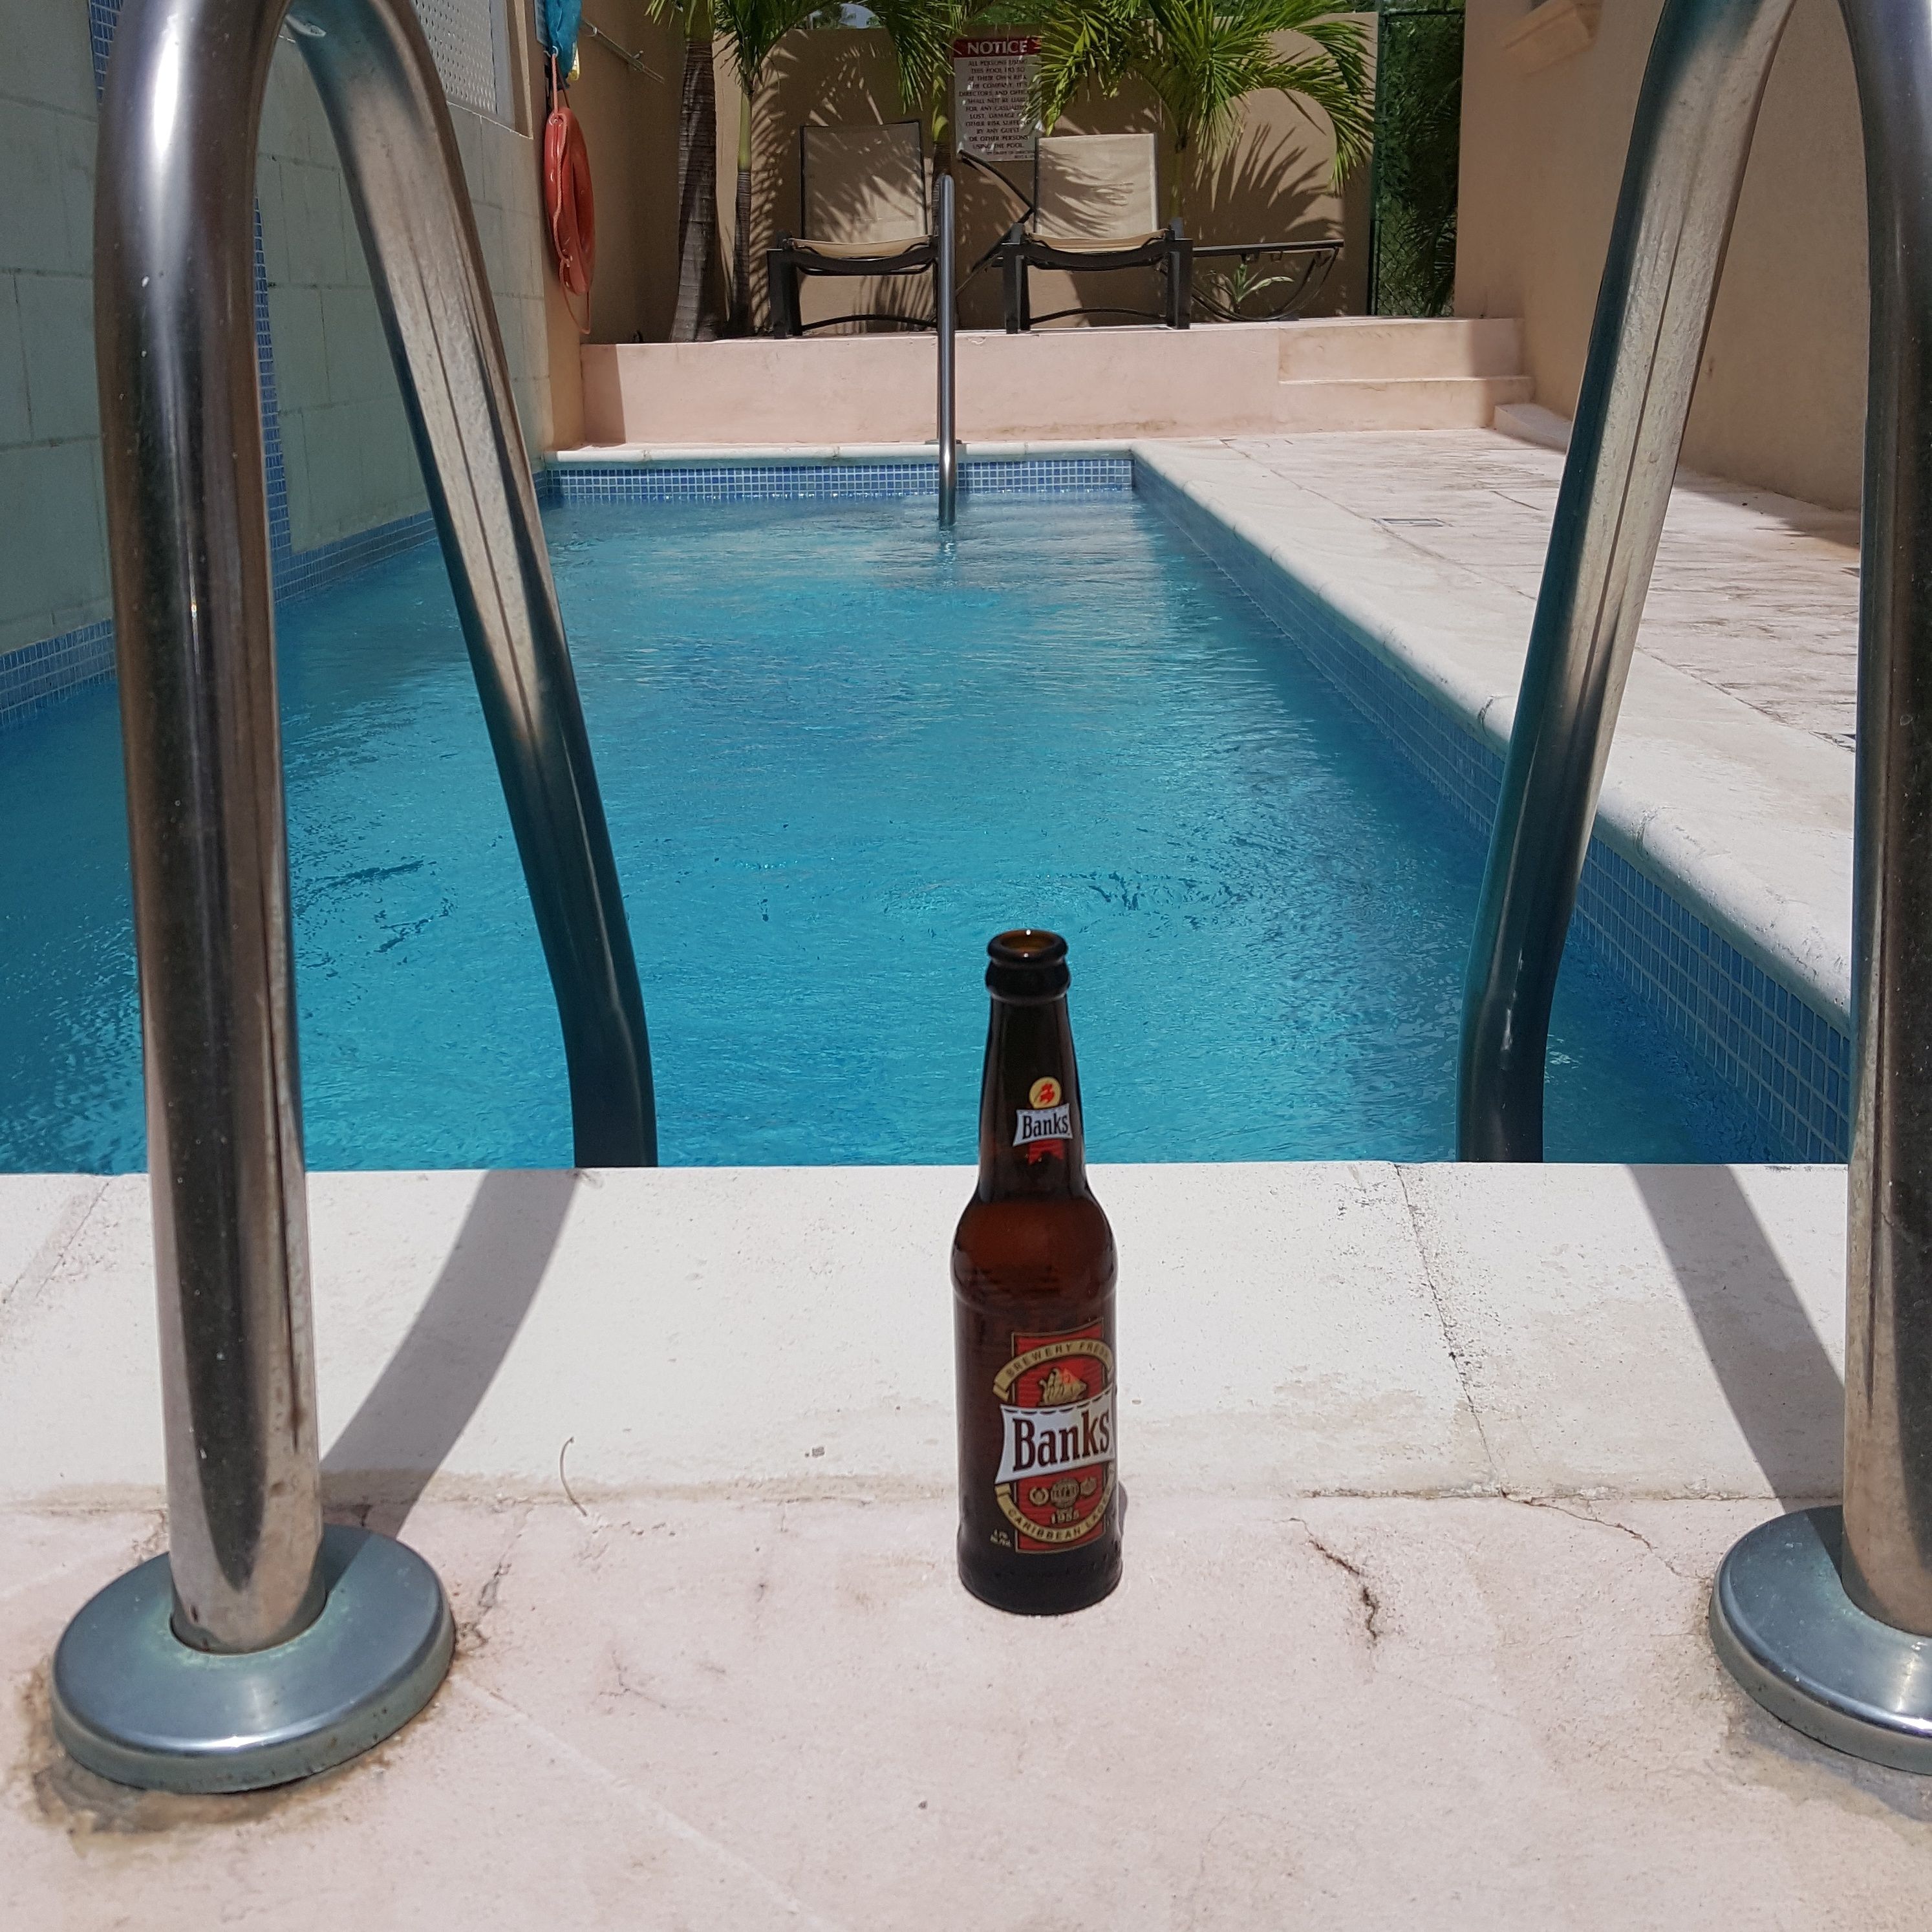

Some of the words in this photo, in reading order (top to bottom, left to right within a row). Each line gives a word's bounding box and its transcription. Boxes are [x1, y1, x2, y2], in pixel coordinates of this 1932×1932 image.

[967, 40, 1027, 55] NOTICE
[1022, 1113, 1068, 1139] Banks
[1005, 1344, 1071, 1377] BREWERY
[1012, 1409, 1110, 1472] Banks
[1007, 1508, 1081, 1539] CARIBBEAN
